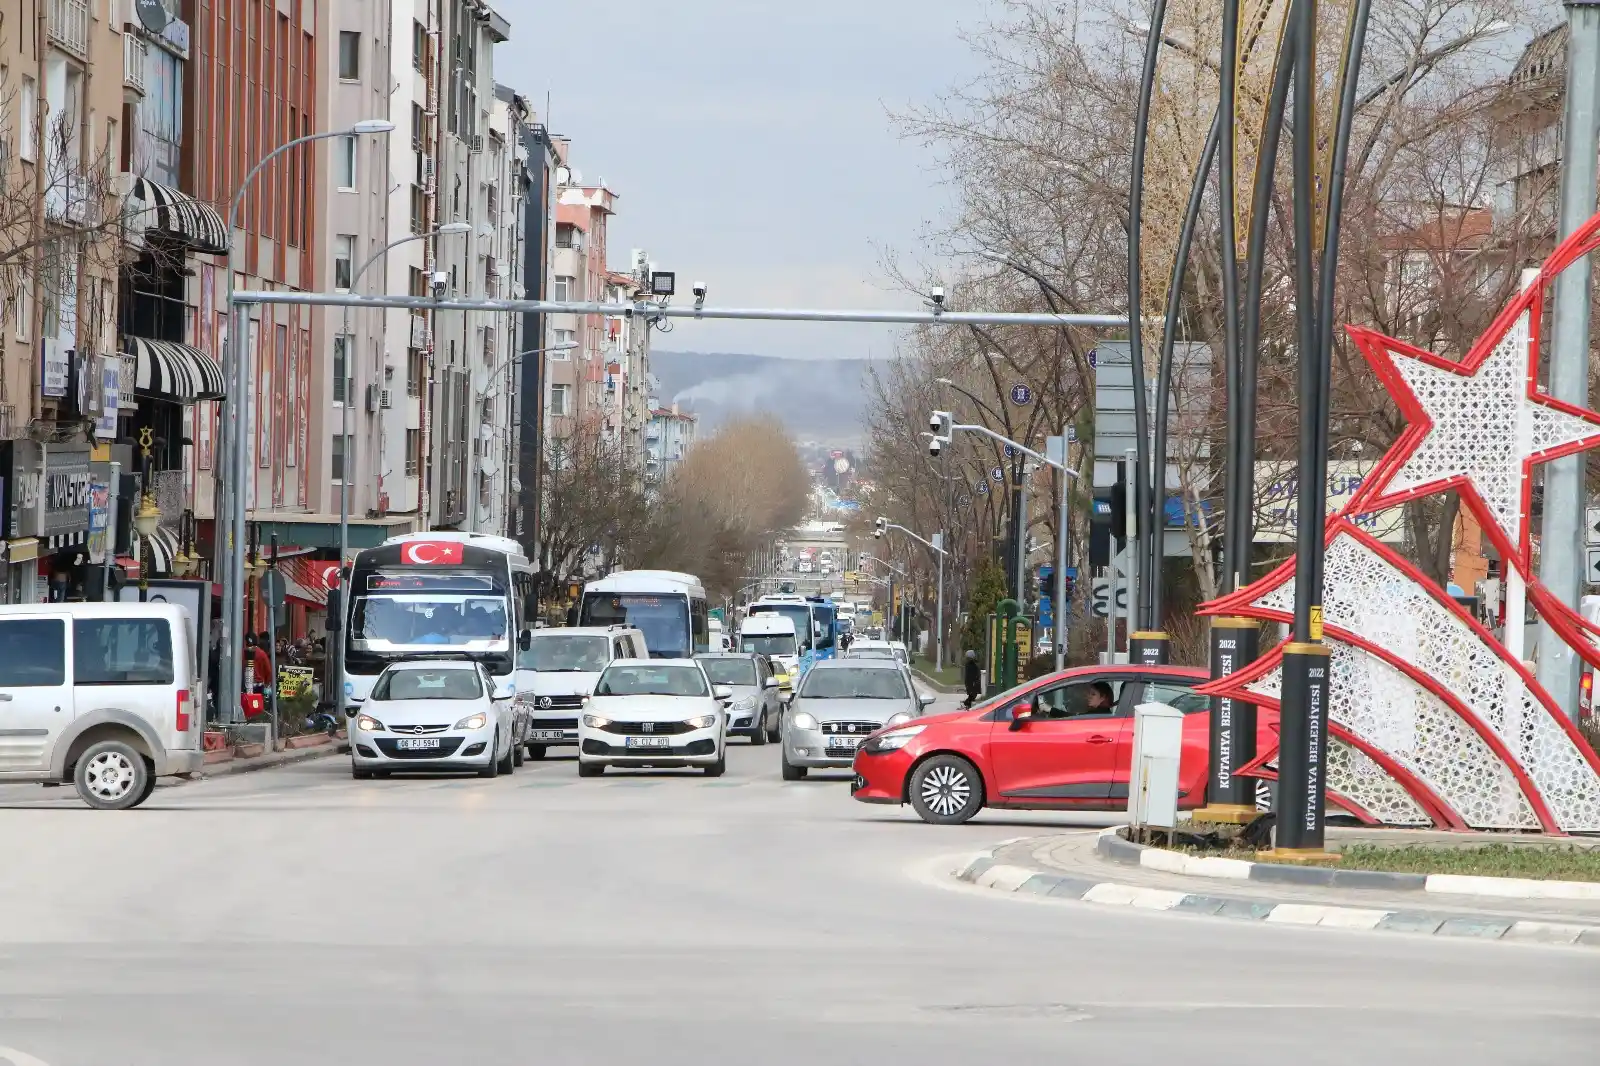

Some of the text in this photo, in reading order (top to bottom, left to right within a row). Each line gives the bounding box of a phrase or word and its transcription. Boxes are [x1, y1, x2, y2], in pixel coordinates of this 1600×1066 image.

[1218, 639, 1236, 649] 2022
[1143, 648, 1159, 656] 2022
[1308, 667, 1325, 678] 2022
[642, 722, 655, 733] FIAT
[412, 739, 420, 747] FJ
[1218, 729, 1231, 789] KÜTAHYA
[1306, 684, 1321, 831] KÜTAHYA BELEDİYESİ
